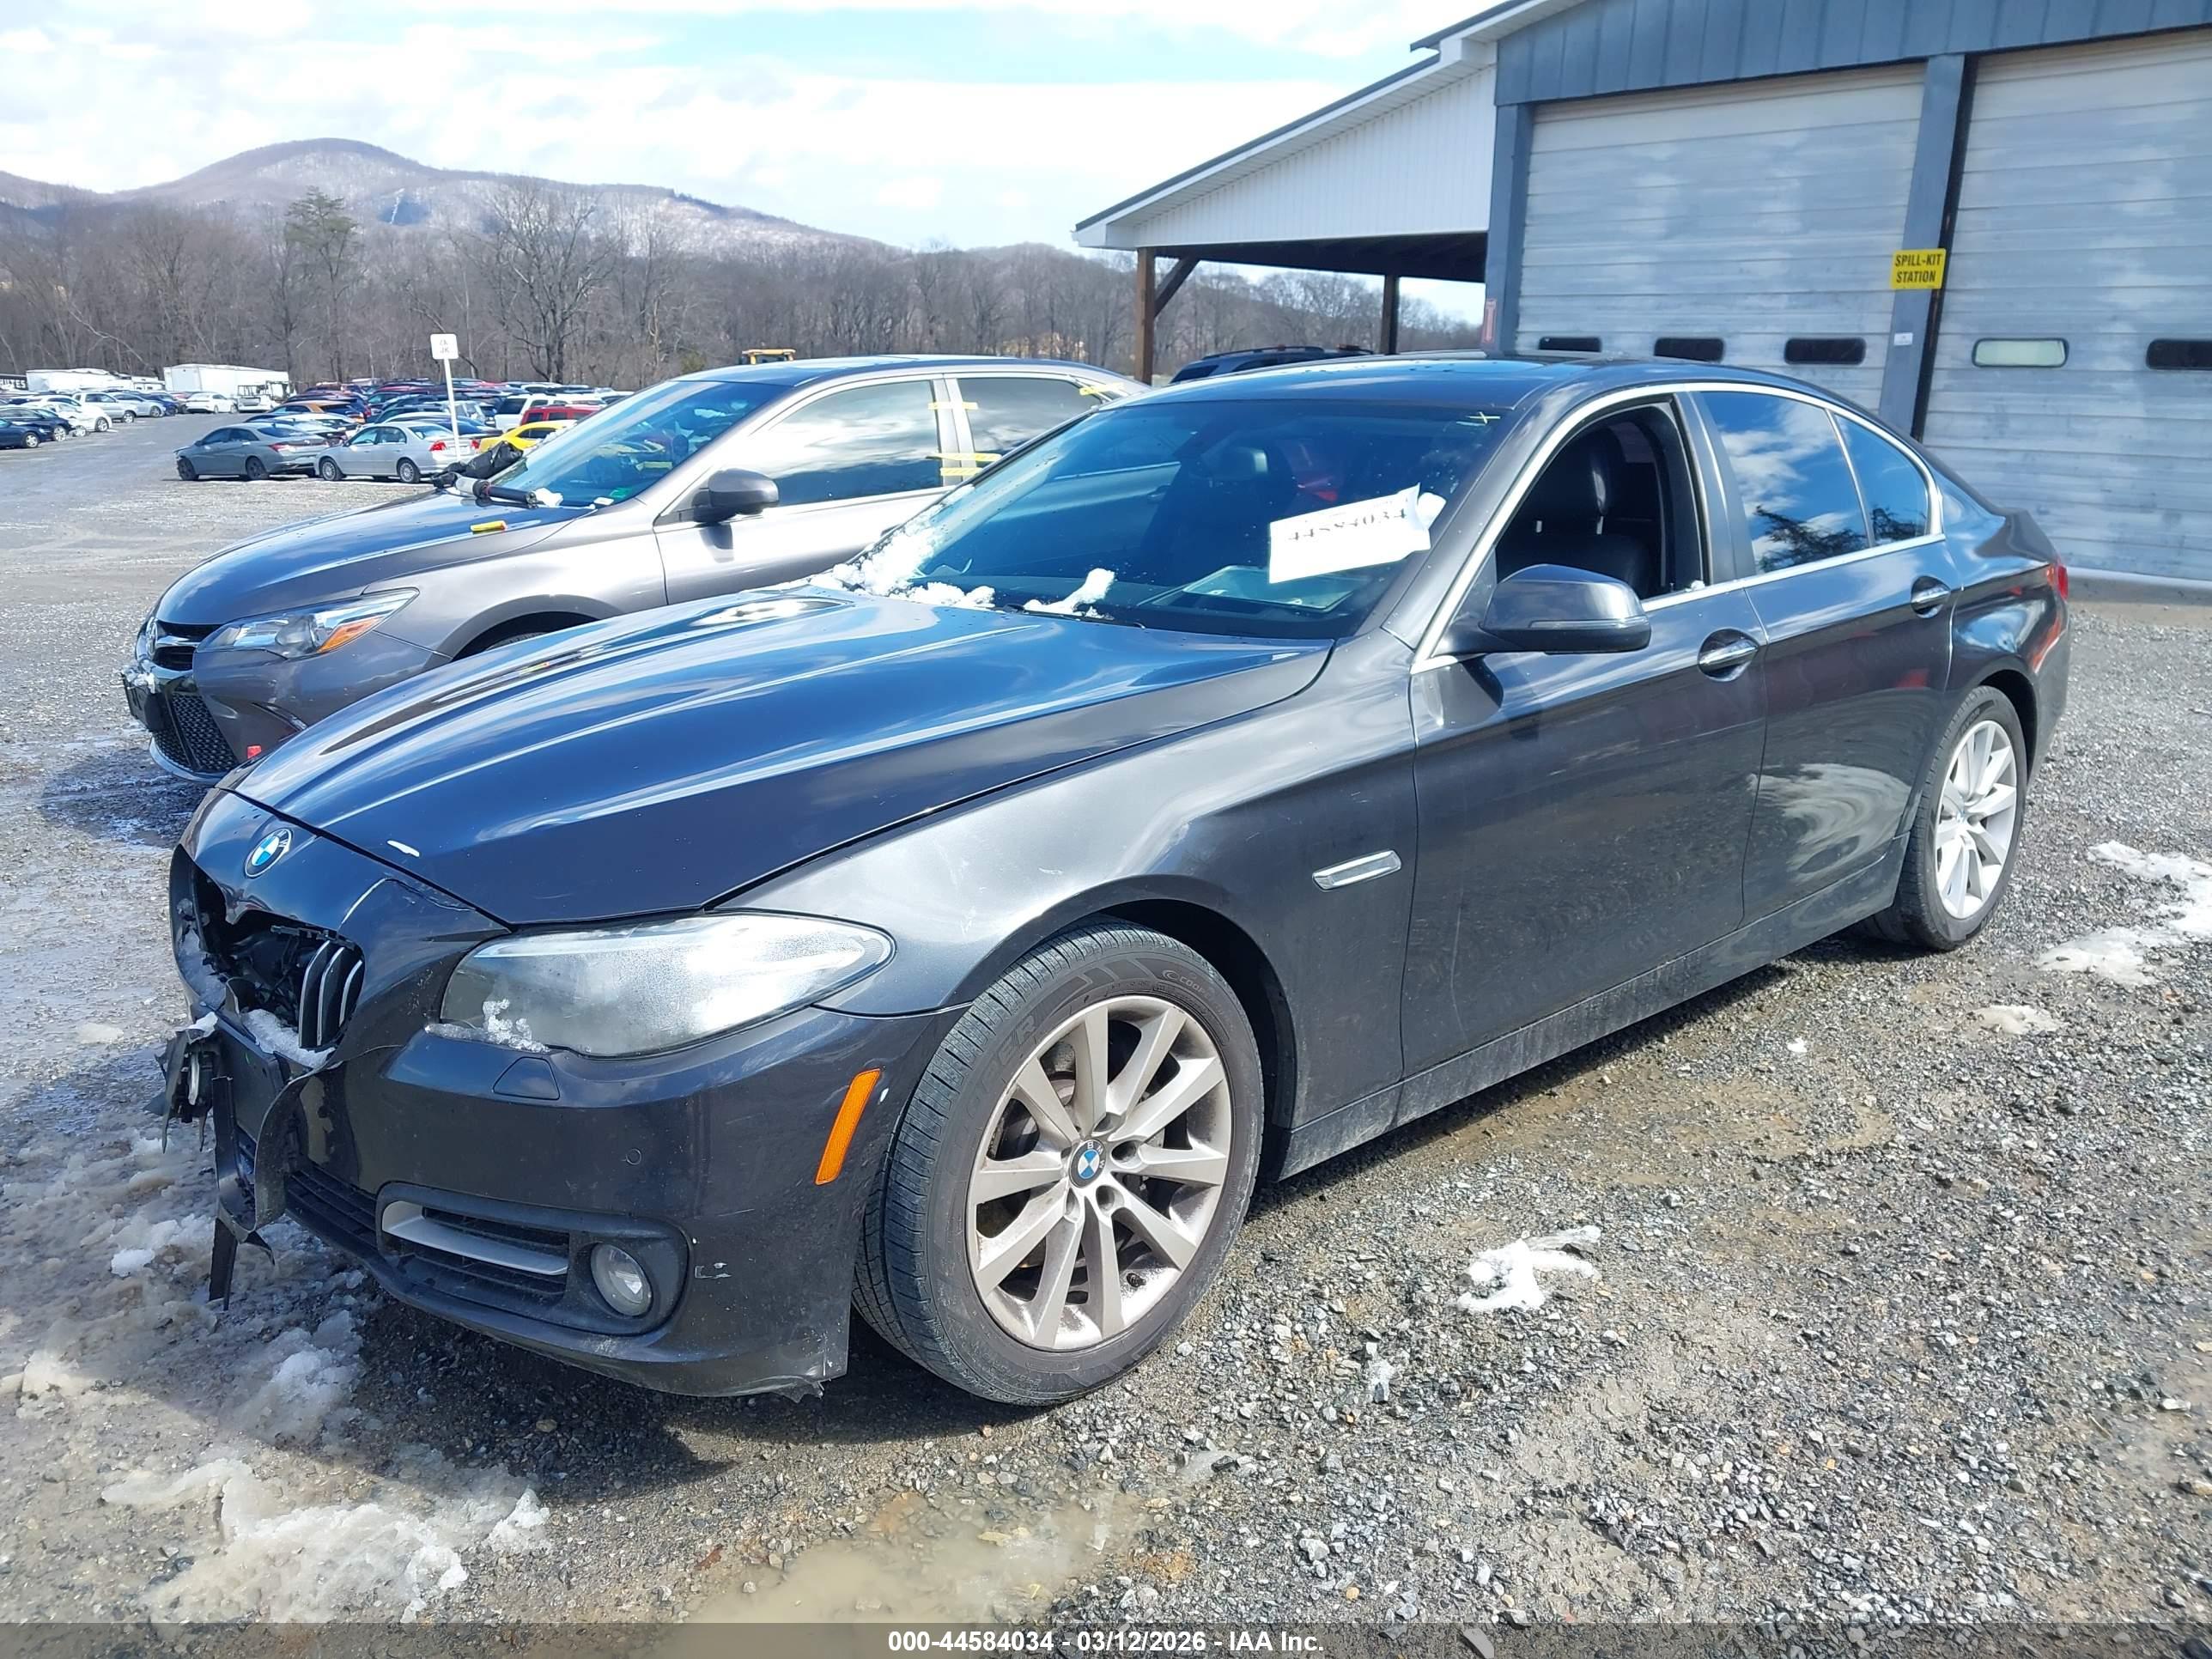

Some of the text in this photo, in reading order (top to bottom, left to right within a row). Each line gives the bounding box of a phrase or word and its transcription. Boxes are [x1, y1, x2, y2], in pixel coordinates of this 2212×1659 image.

[1894, 253, 1942, 267] SPILL-KIT
[1896, 270, 1936, 283] STATION
[1087, 1141, 1105, 1169] BMW
